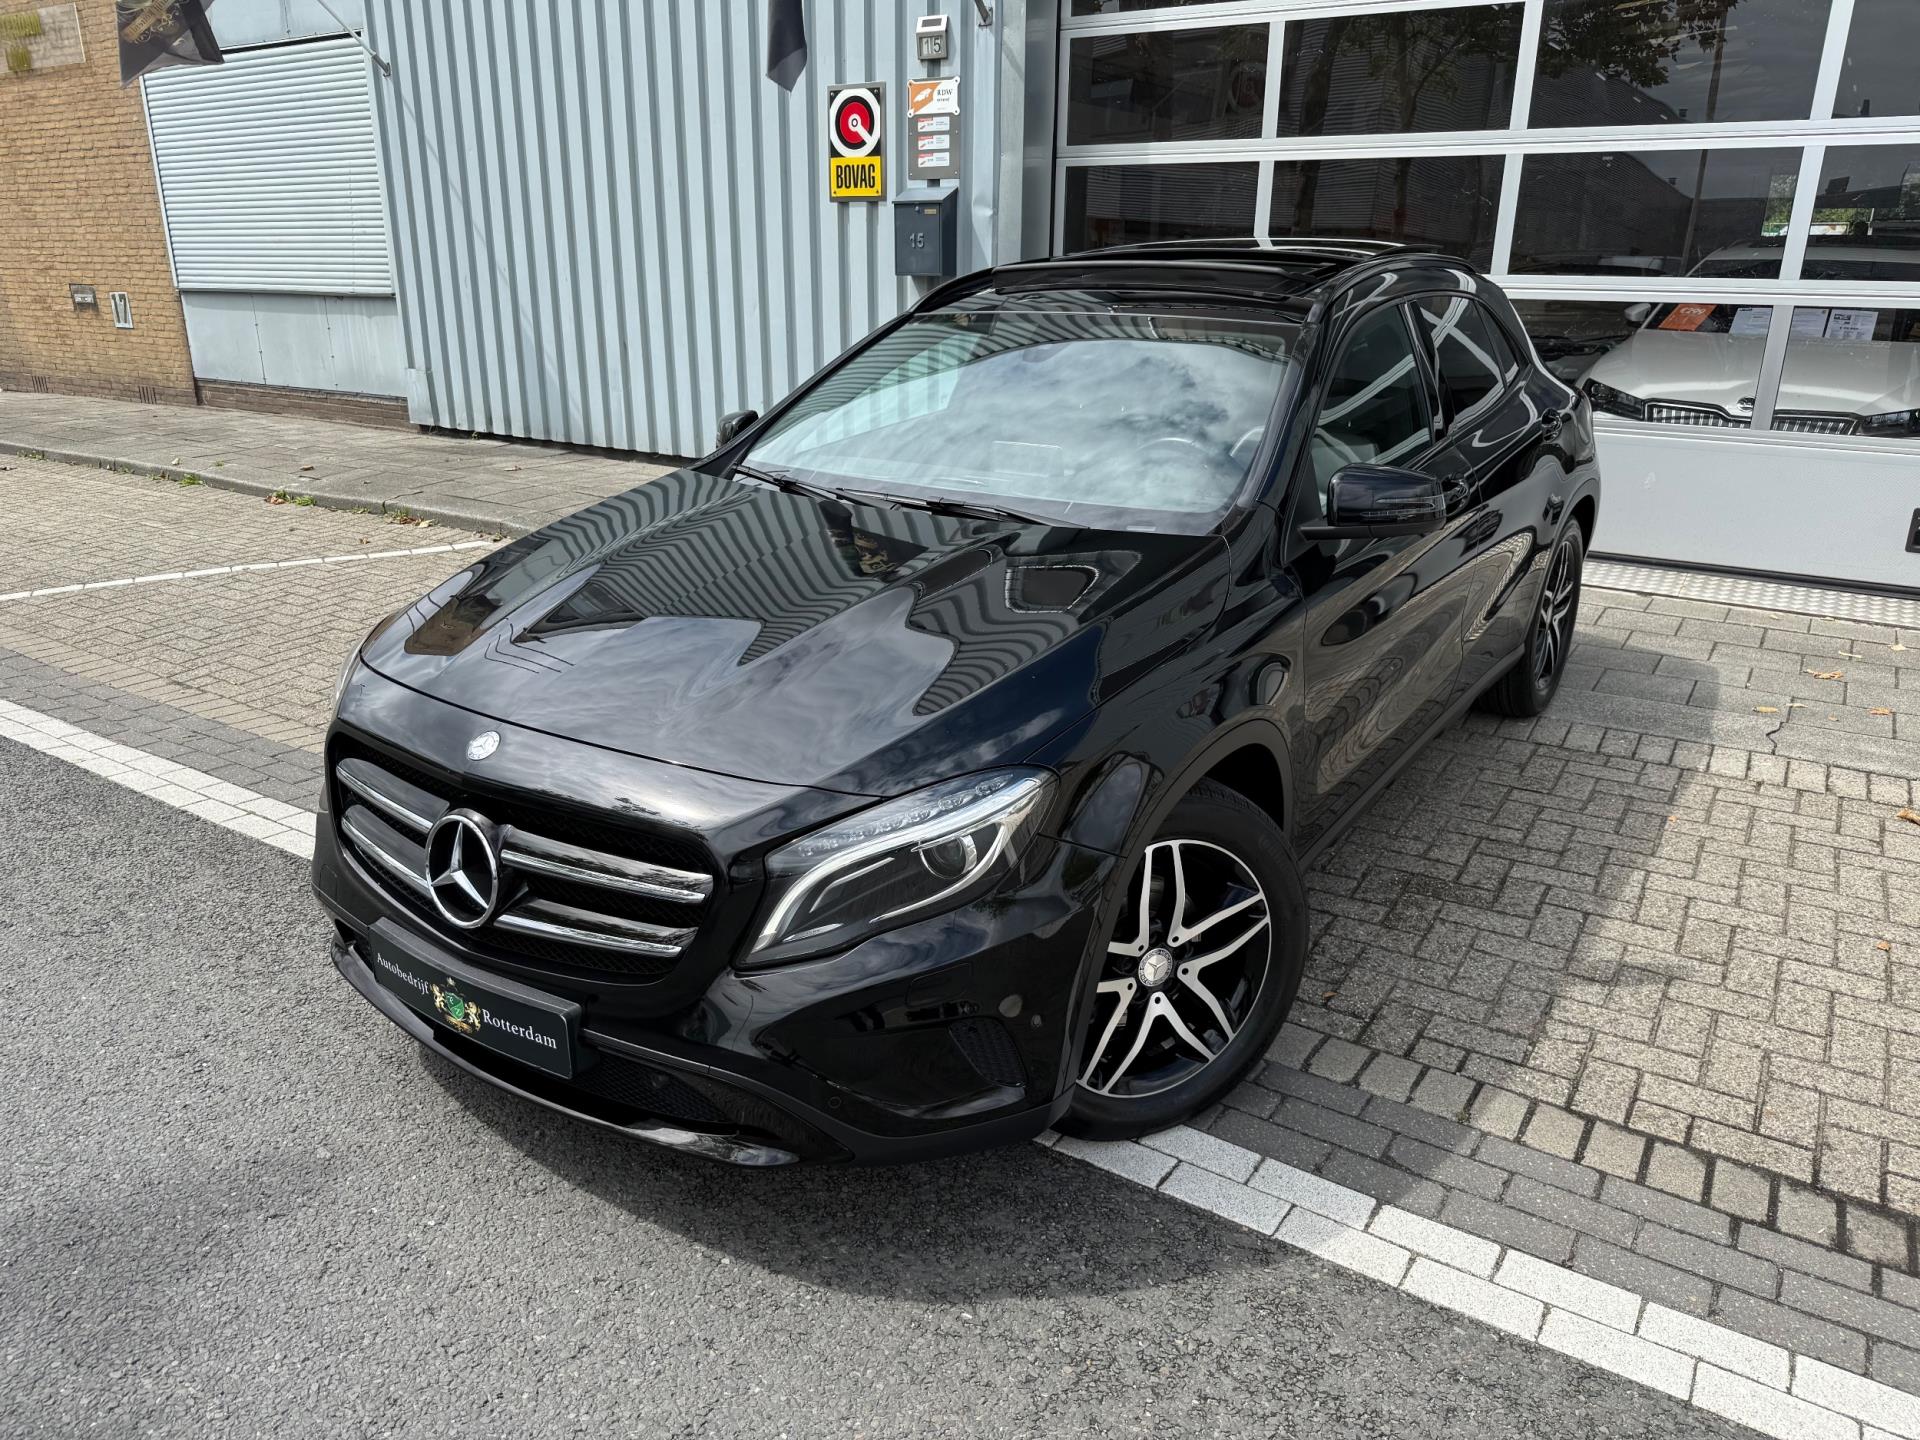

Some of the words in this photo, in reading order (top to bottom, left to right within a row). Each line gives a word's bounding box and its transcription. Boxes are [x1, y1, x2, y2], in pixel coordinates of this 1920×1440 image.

[923, 38, 941, 54] 15
[836, 164, 876, 189] BOVAG
[909, 232, 925, 248] 15
[377, 952, 430, 995] Autobedrijf
[481, 1008, 557, 1049] Rotterdam
